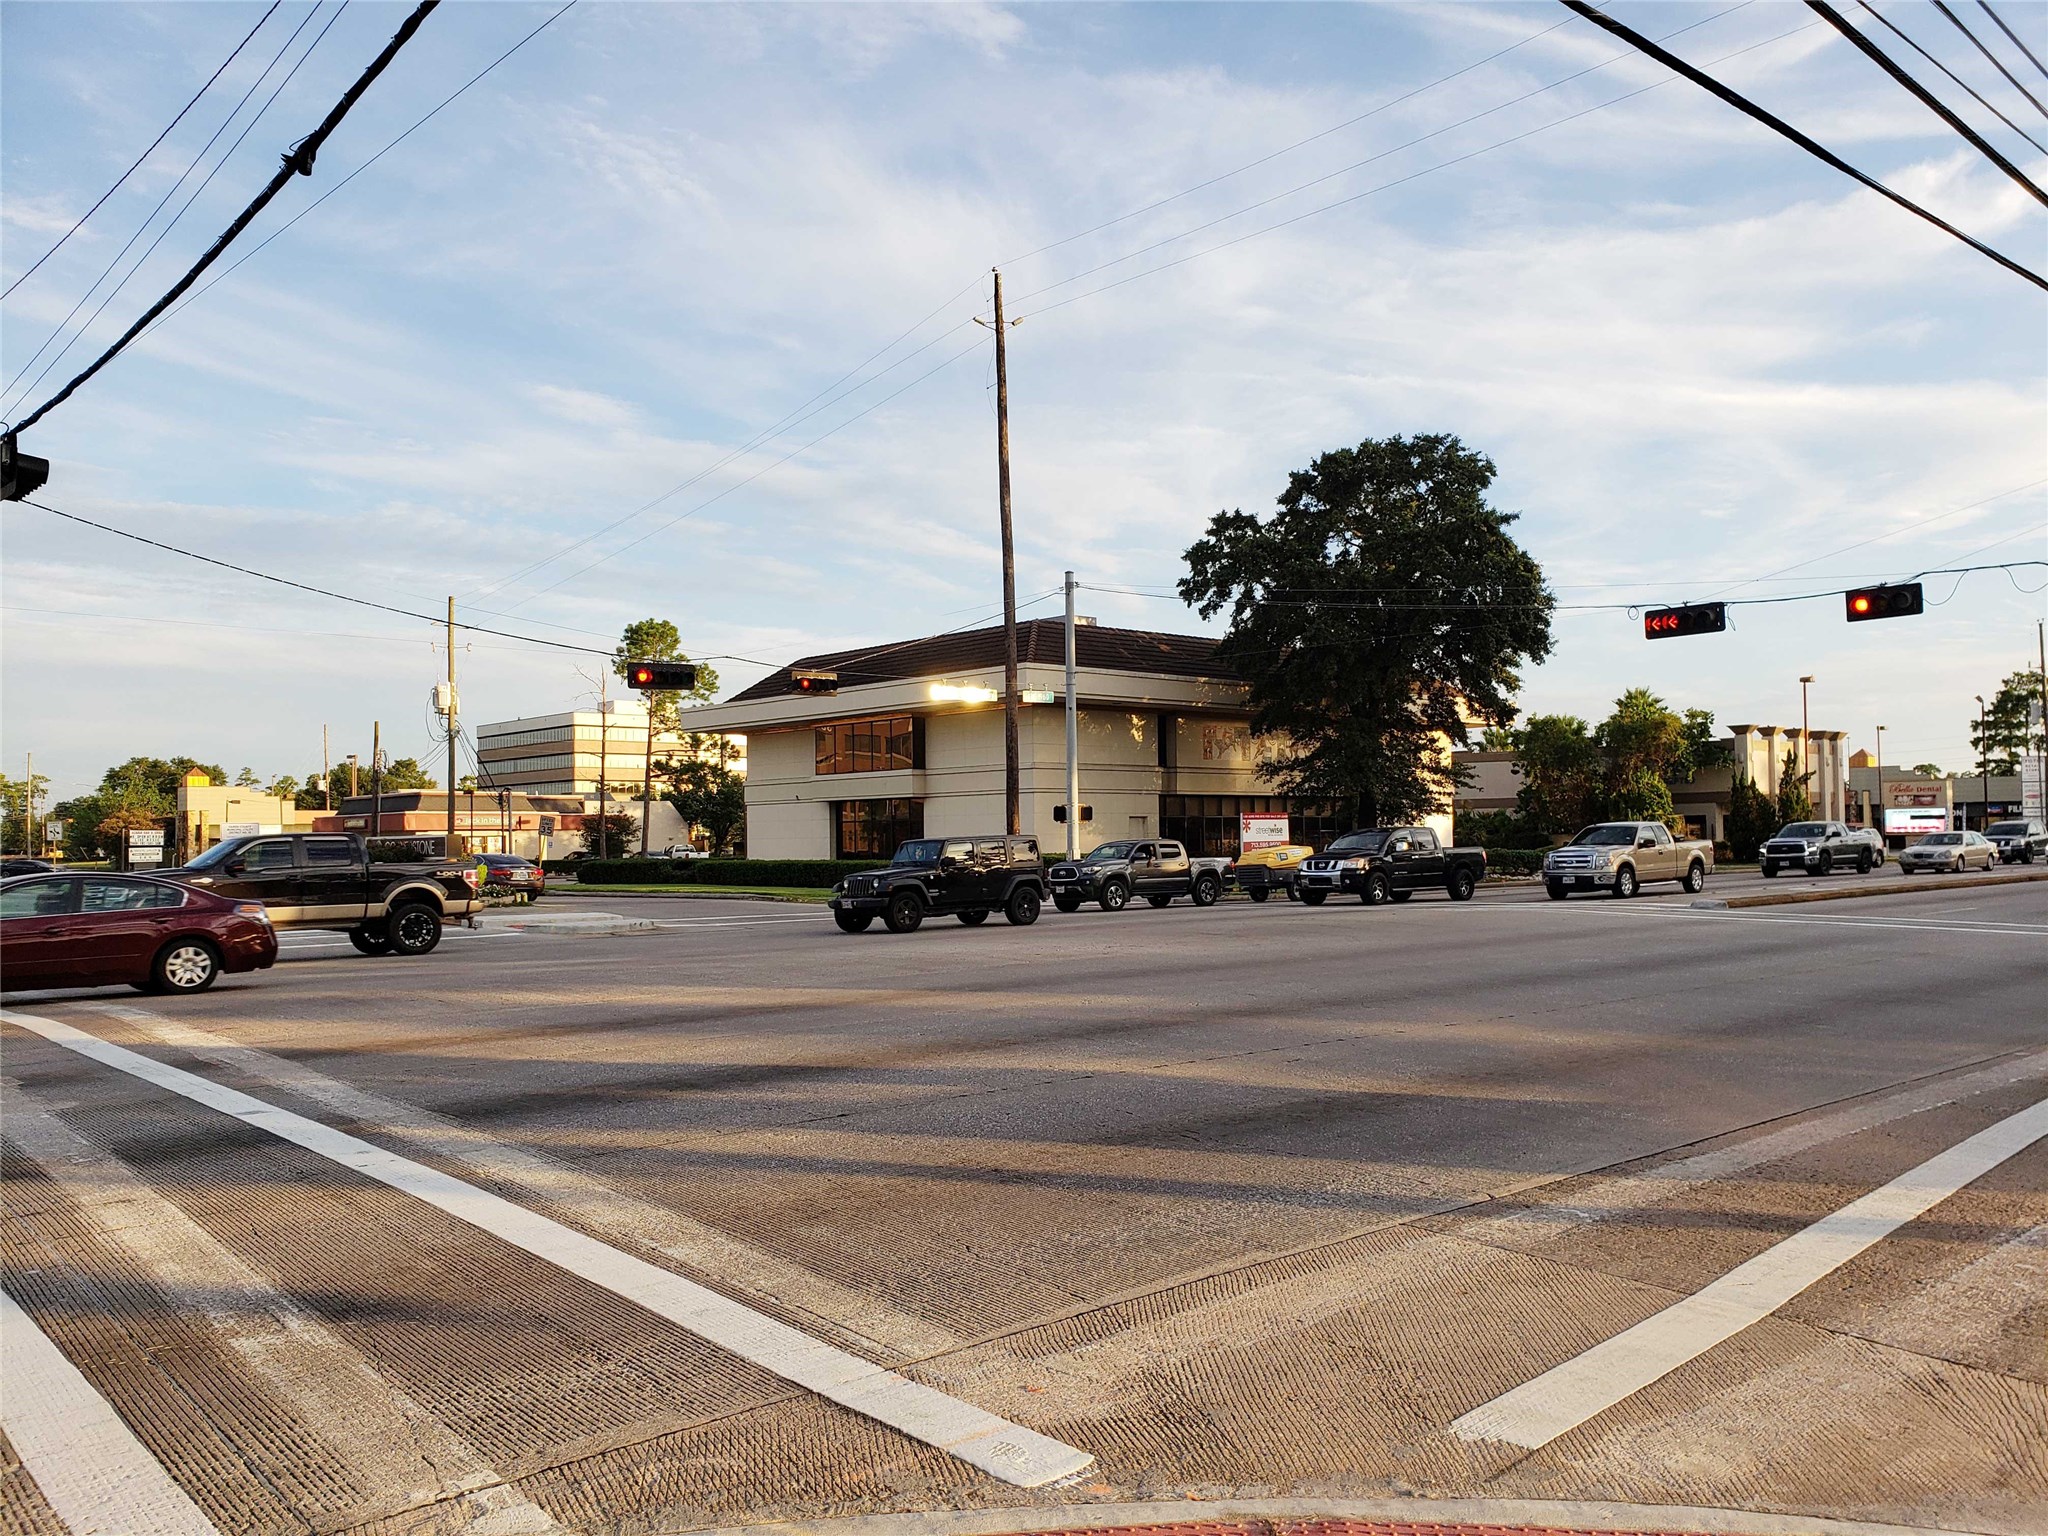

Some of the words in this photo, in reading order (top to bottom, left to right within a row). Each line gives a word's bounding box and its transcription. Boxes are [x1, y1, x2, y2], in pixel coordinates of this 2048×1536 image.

[1888, 784, 1914, 793] Bella
[1916, 785, 1942, 793] Dental
[540, 826, 552, 834] 35
[1255, 824, 1283, 835] streetwise
